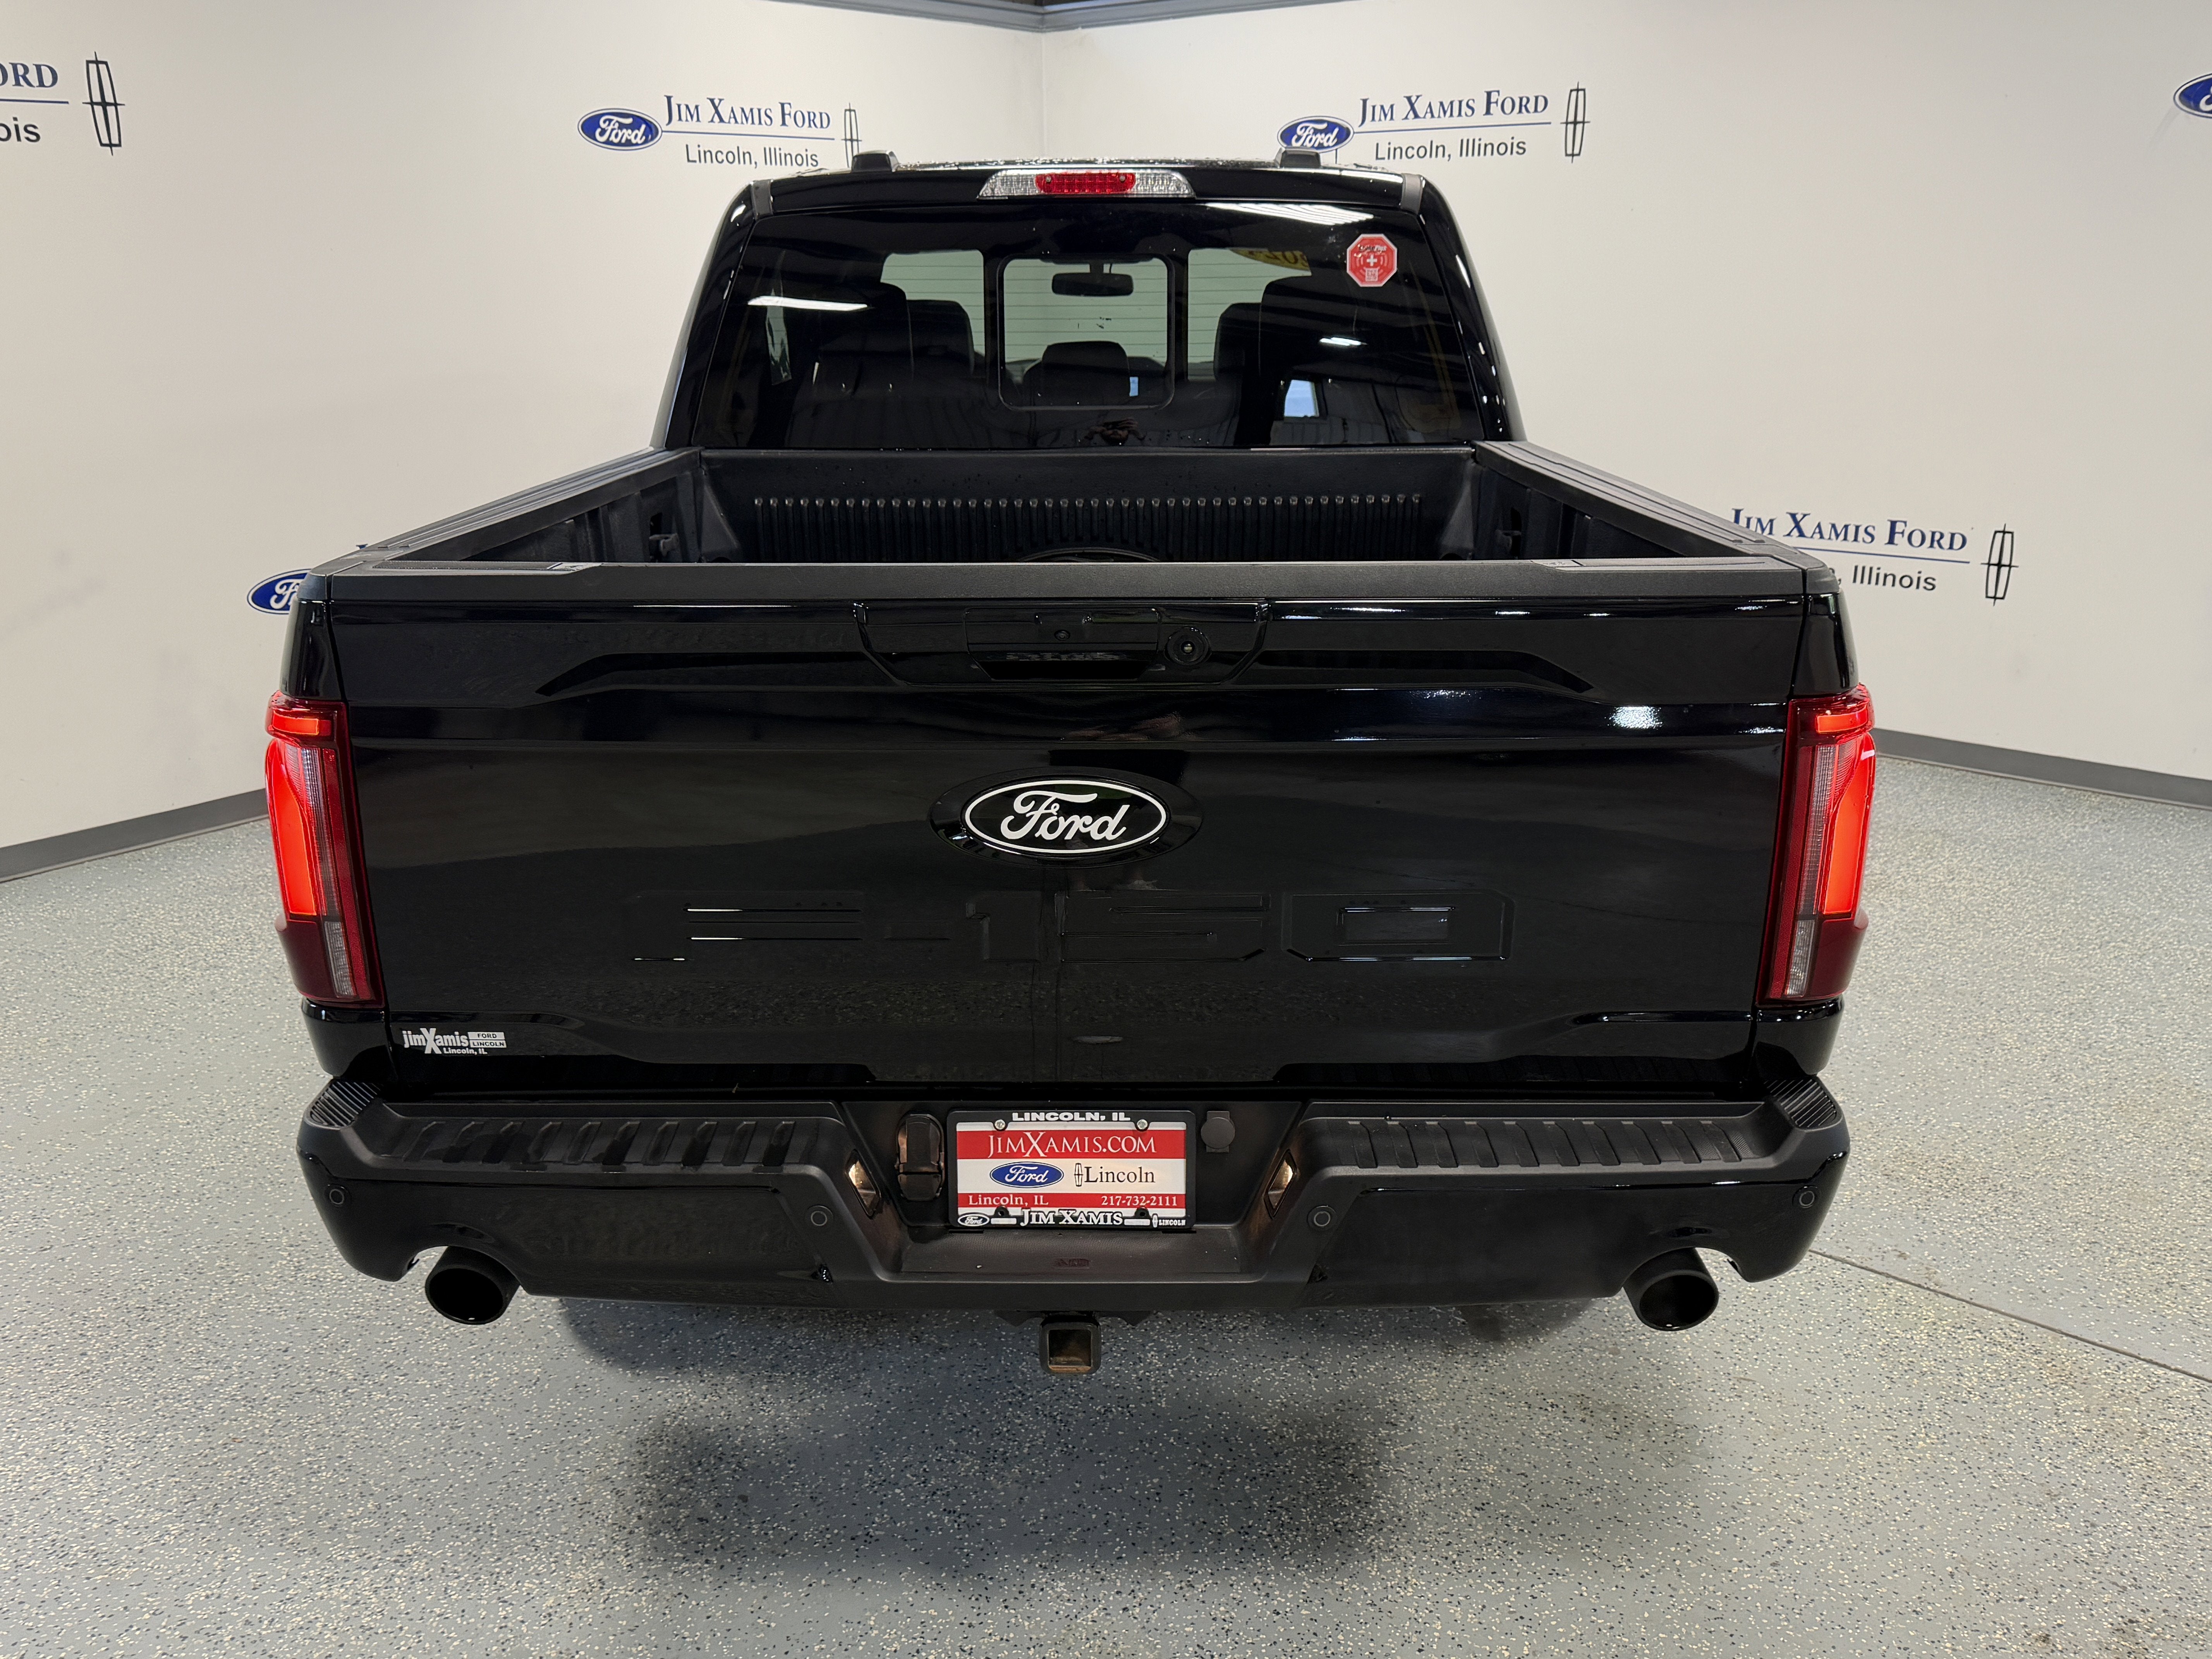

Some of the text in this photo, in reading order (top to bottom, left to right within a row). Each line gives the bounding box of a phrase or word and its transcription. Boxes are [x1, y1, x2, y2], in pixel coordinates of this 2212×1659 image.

[664, 95, 830, 129] JIM XAMIS FORD
[1358, 90, 1548, 127] JIM XAMIS FORD
[593, 115, 647, 144] Ford
[1291, 122, 1339, 147] Ford
[685, 144, 818, 168] Lincoln, Illinois
[1376, 136, 1526, 161] Lincoln, Illinois
[1783, 512, 1875, 544] XAMIS
[1884, 520, 1967, 550] FORD
[1853, 565, 1936, 591] Illinois
[999, 789, 1132, 840] Ford
[1011, 1112, 1132, 1123] LINCOLN, IL
[988, 1132, 1156, 1159] JIMXAMIS.COM
[1005, 1166, 1049, 1182] Ford
[1084, 1166, 1155, 1183] Lincoln
[969, 1194, 1049, 1206] Lincoln, IL
[1101, 1195, 1177, 1206] 217-732-2111
[964, 1216, 983, 1225] Ford
[1020, 1209, 1123, 1226] JIM XAMIS
